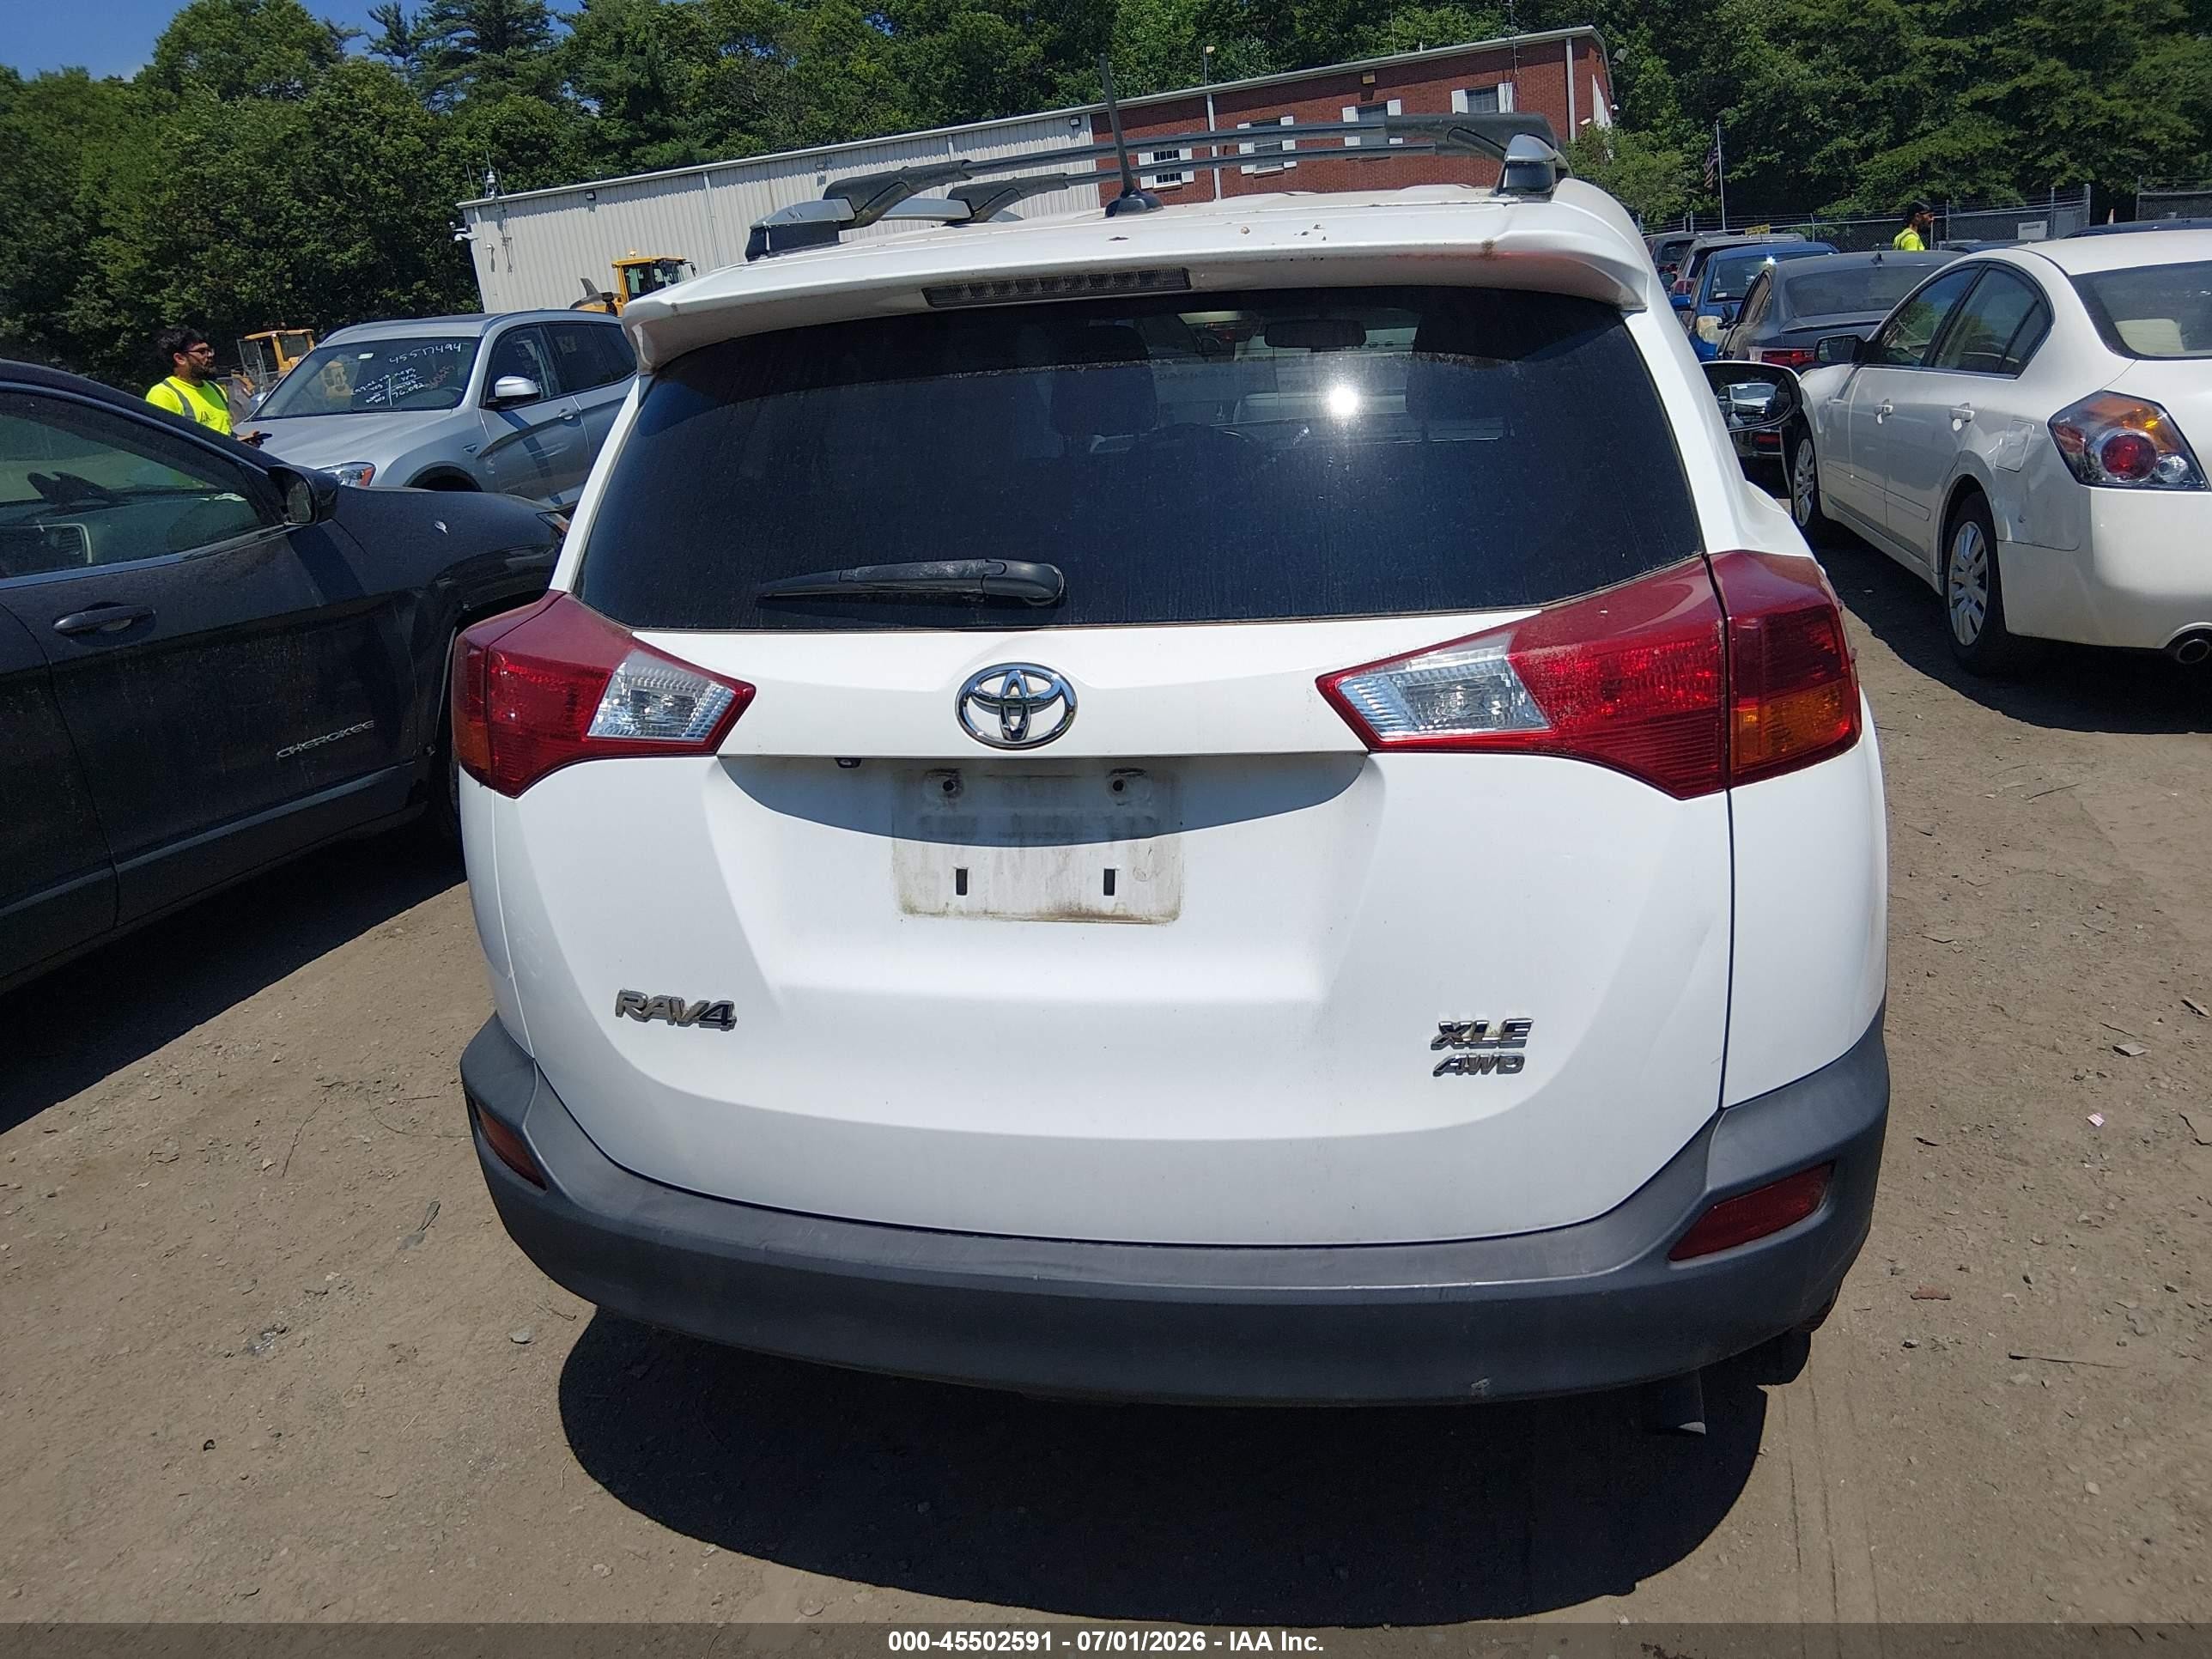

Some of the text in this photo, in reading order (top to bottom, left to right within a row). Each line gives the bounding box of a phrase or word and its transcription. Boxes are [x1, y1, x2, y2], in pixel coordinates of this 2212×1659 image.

[615, 989, 738, 1032] RAV4
[1430, 1018, 1534, 1051] XLE
[1432, 1051, 1526, 1077] AWD
